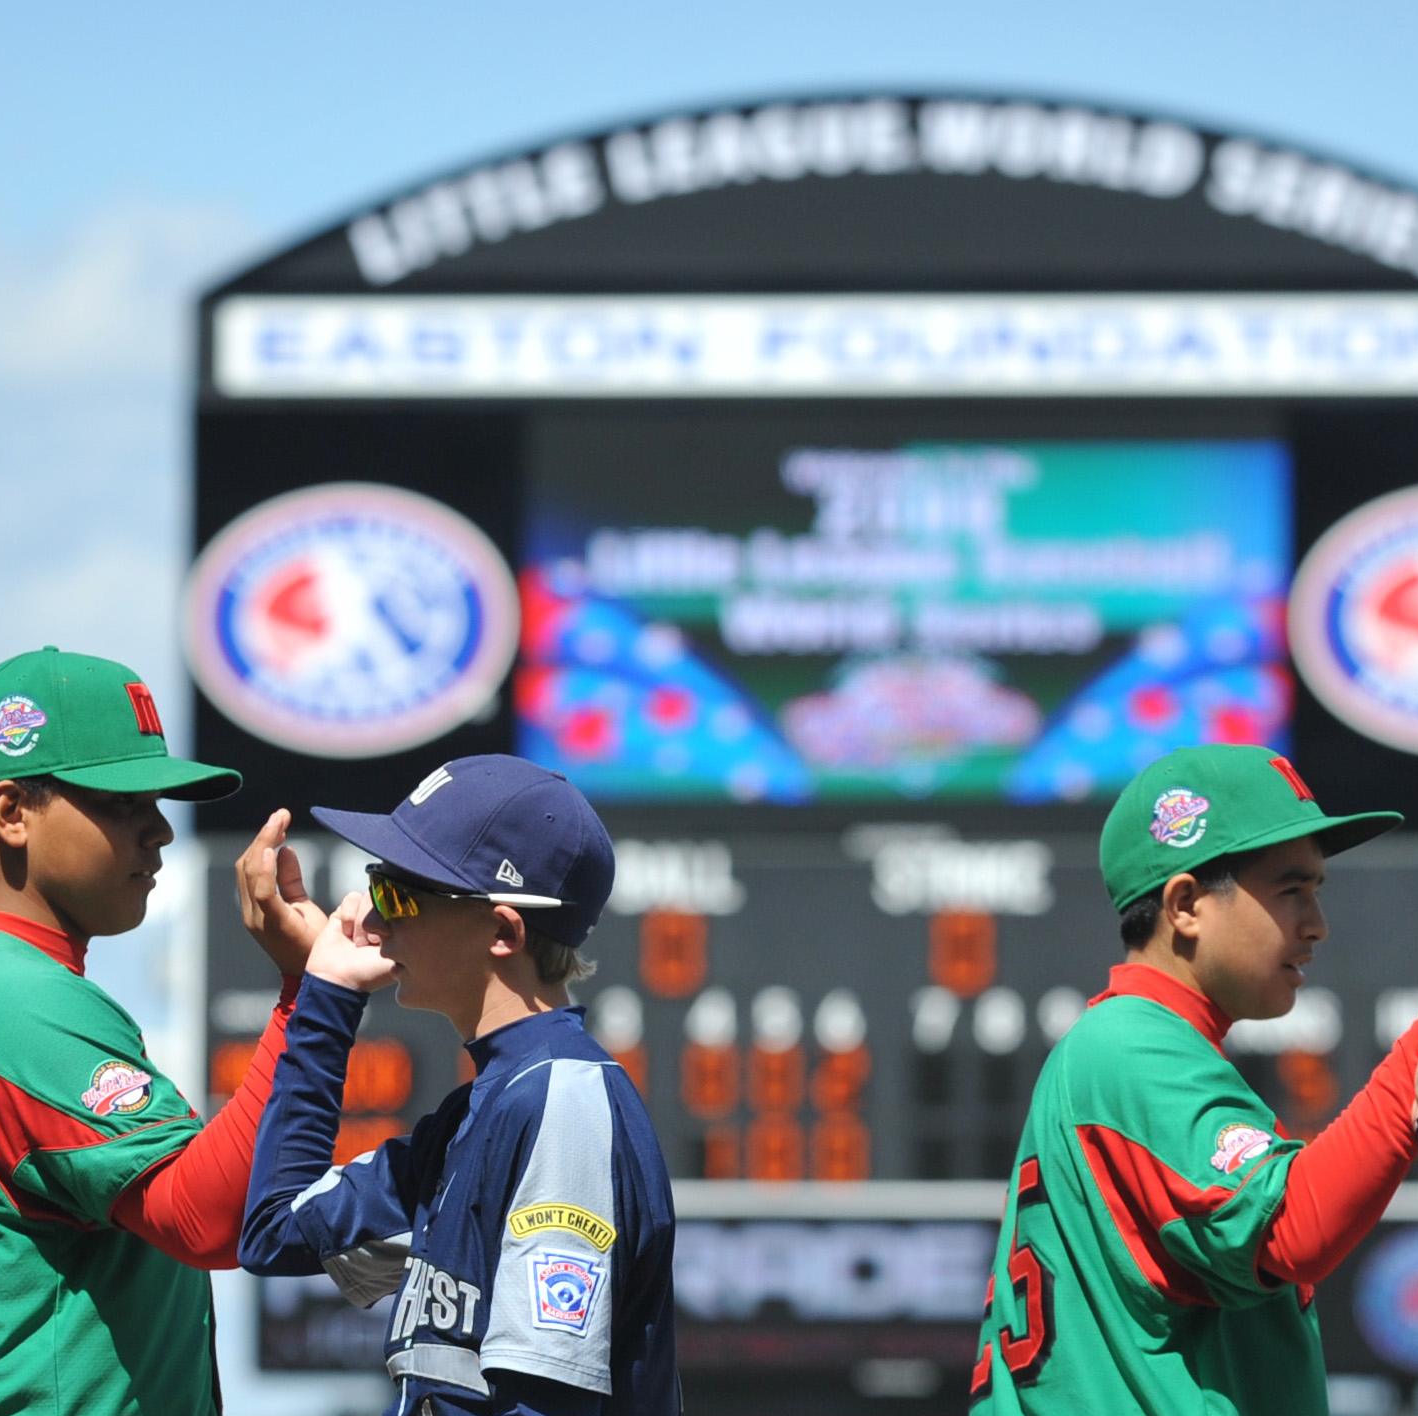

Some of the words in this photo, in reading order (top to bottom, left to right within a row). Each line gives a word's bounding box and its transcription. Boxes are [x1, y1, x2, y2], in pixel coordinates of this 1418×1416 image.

[605, 99, 911, 201] LEAGUE
[918, 99, 1204, 198] WORLD
[255, 320, 701, 369] EASTON
[525, 1209, 565, 1227] WON'T
[567, 1212, 609, 1244] CHEAT!
